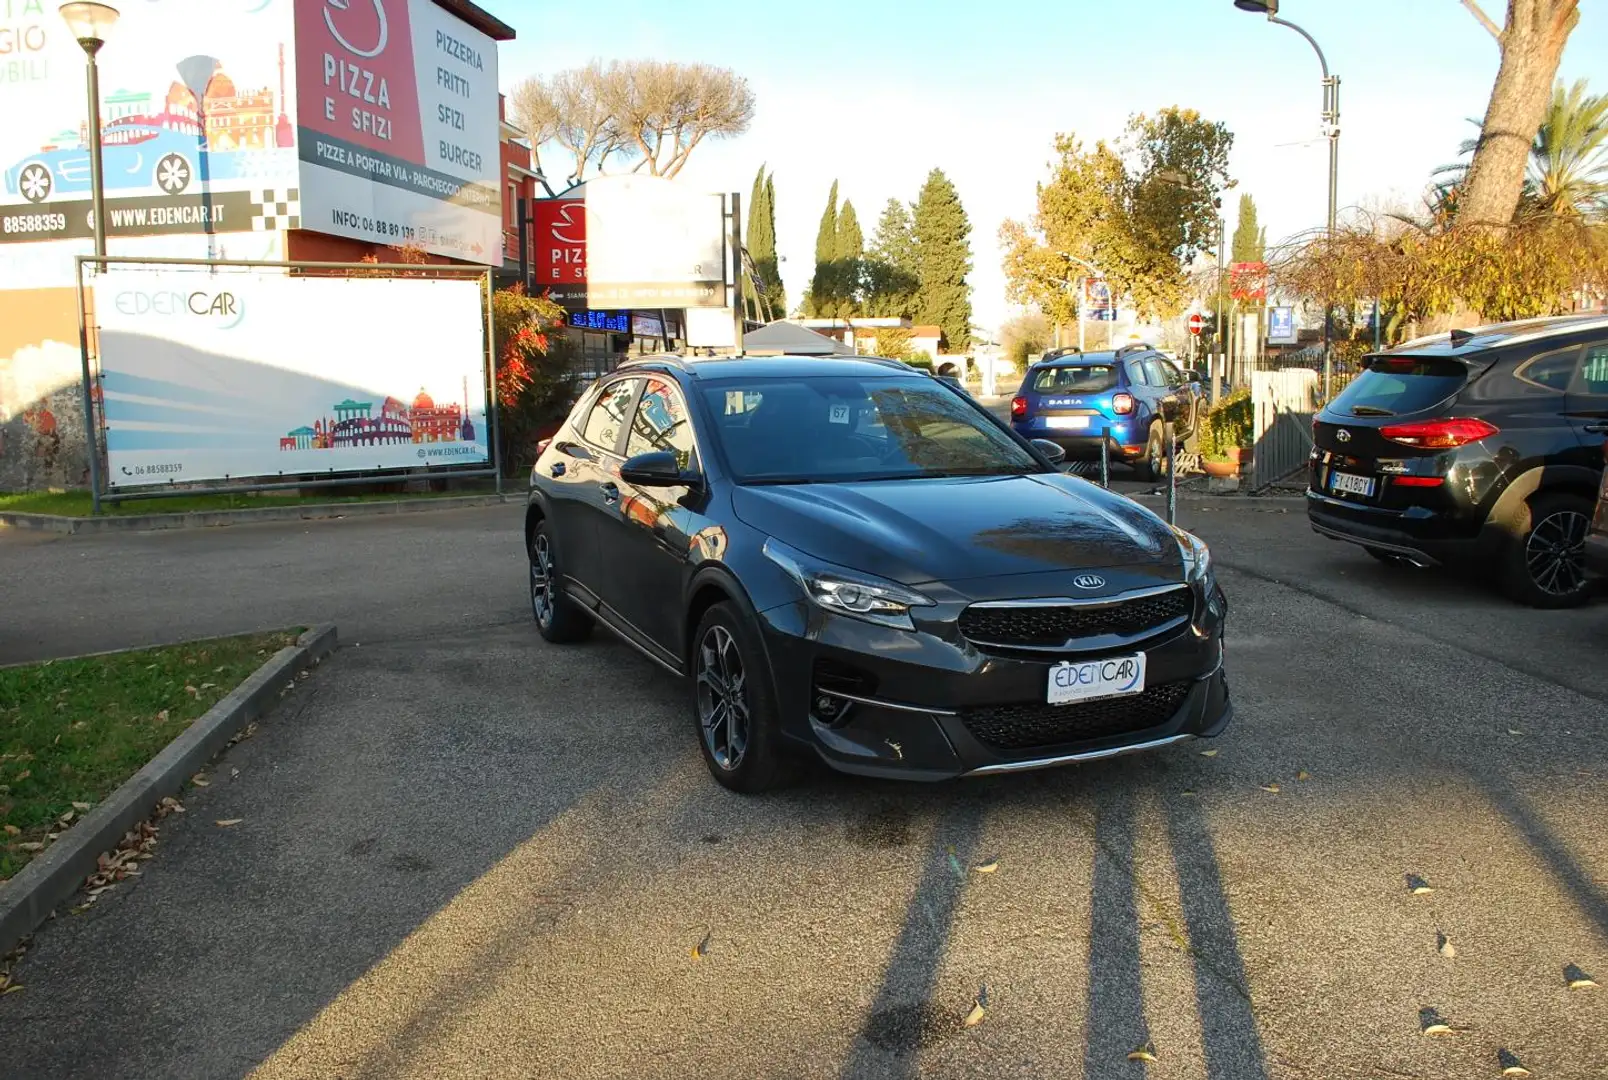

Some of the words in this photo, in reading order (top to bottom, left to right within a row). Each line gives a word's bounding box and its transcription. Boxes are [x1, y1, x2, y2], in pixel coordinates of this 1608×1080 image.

[436, 29, 484, 73] PIZZERIA
[0, 60, 47, 83] BILI
[323, 53, 390, 110] PIZZA
[437, 67, 471, 98] FRITTI
[325, 96, 336, 121] E
[352, 107, 393, 141] SFIZI
[438, 103, 466, 131] SFIZI
[316, 141, 346, 164] PIZZE
[347, 152, 356, 166] A
[356, 154, 391, 177] PORTAR
[393, 165, 409, 182] VIA
[413, 174, 460, 197] PARCHEGGIO
[440, 140, 483, 173] BURGER
[4, 213, 66, 234] 88588359
[110, 205, 225, 228] WWW.EDENCAR.IT
[332, 209, 361, 230] INFO:
[363, 217, 374, 232] 06
[376, 220, 388, 236] 88
[389, 223, 399, 238] 89
[401, 225, 415, 241] 139
[552, 248, 586, 263] PIZ
[552, 268, 560, 278] E
[115, 290, 237, 316] EDENCAR
[834, 407, 845, 418] 67
[427, 446, 477, 457] WWW.EDENCAR.IT
[135, 465, 144, 475] 06
[1077, 575, 1103, 587] KIA
[1055, 660, 1134, 687] EDENCAR
